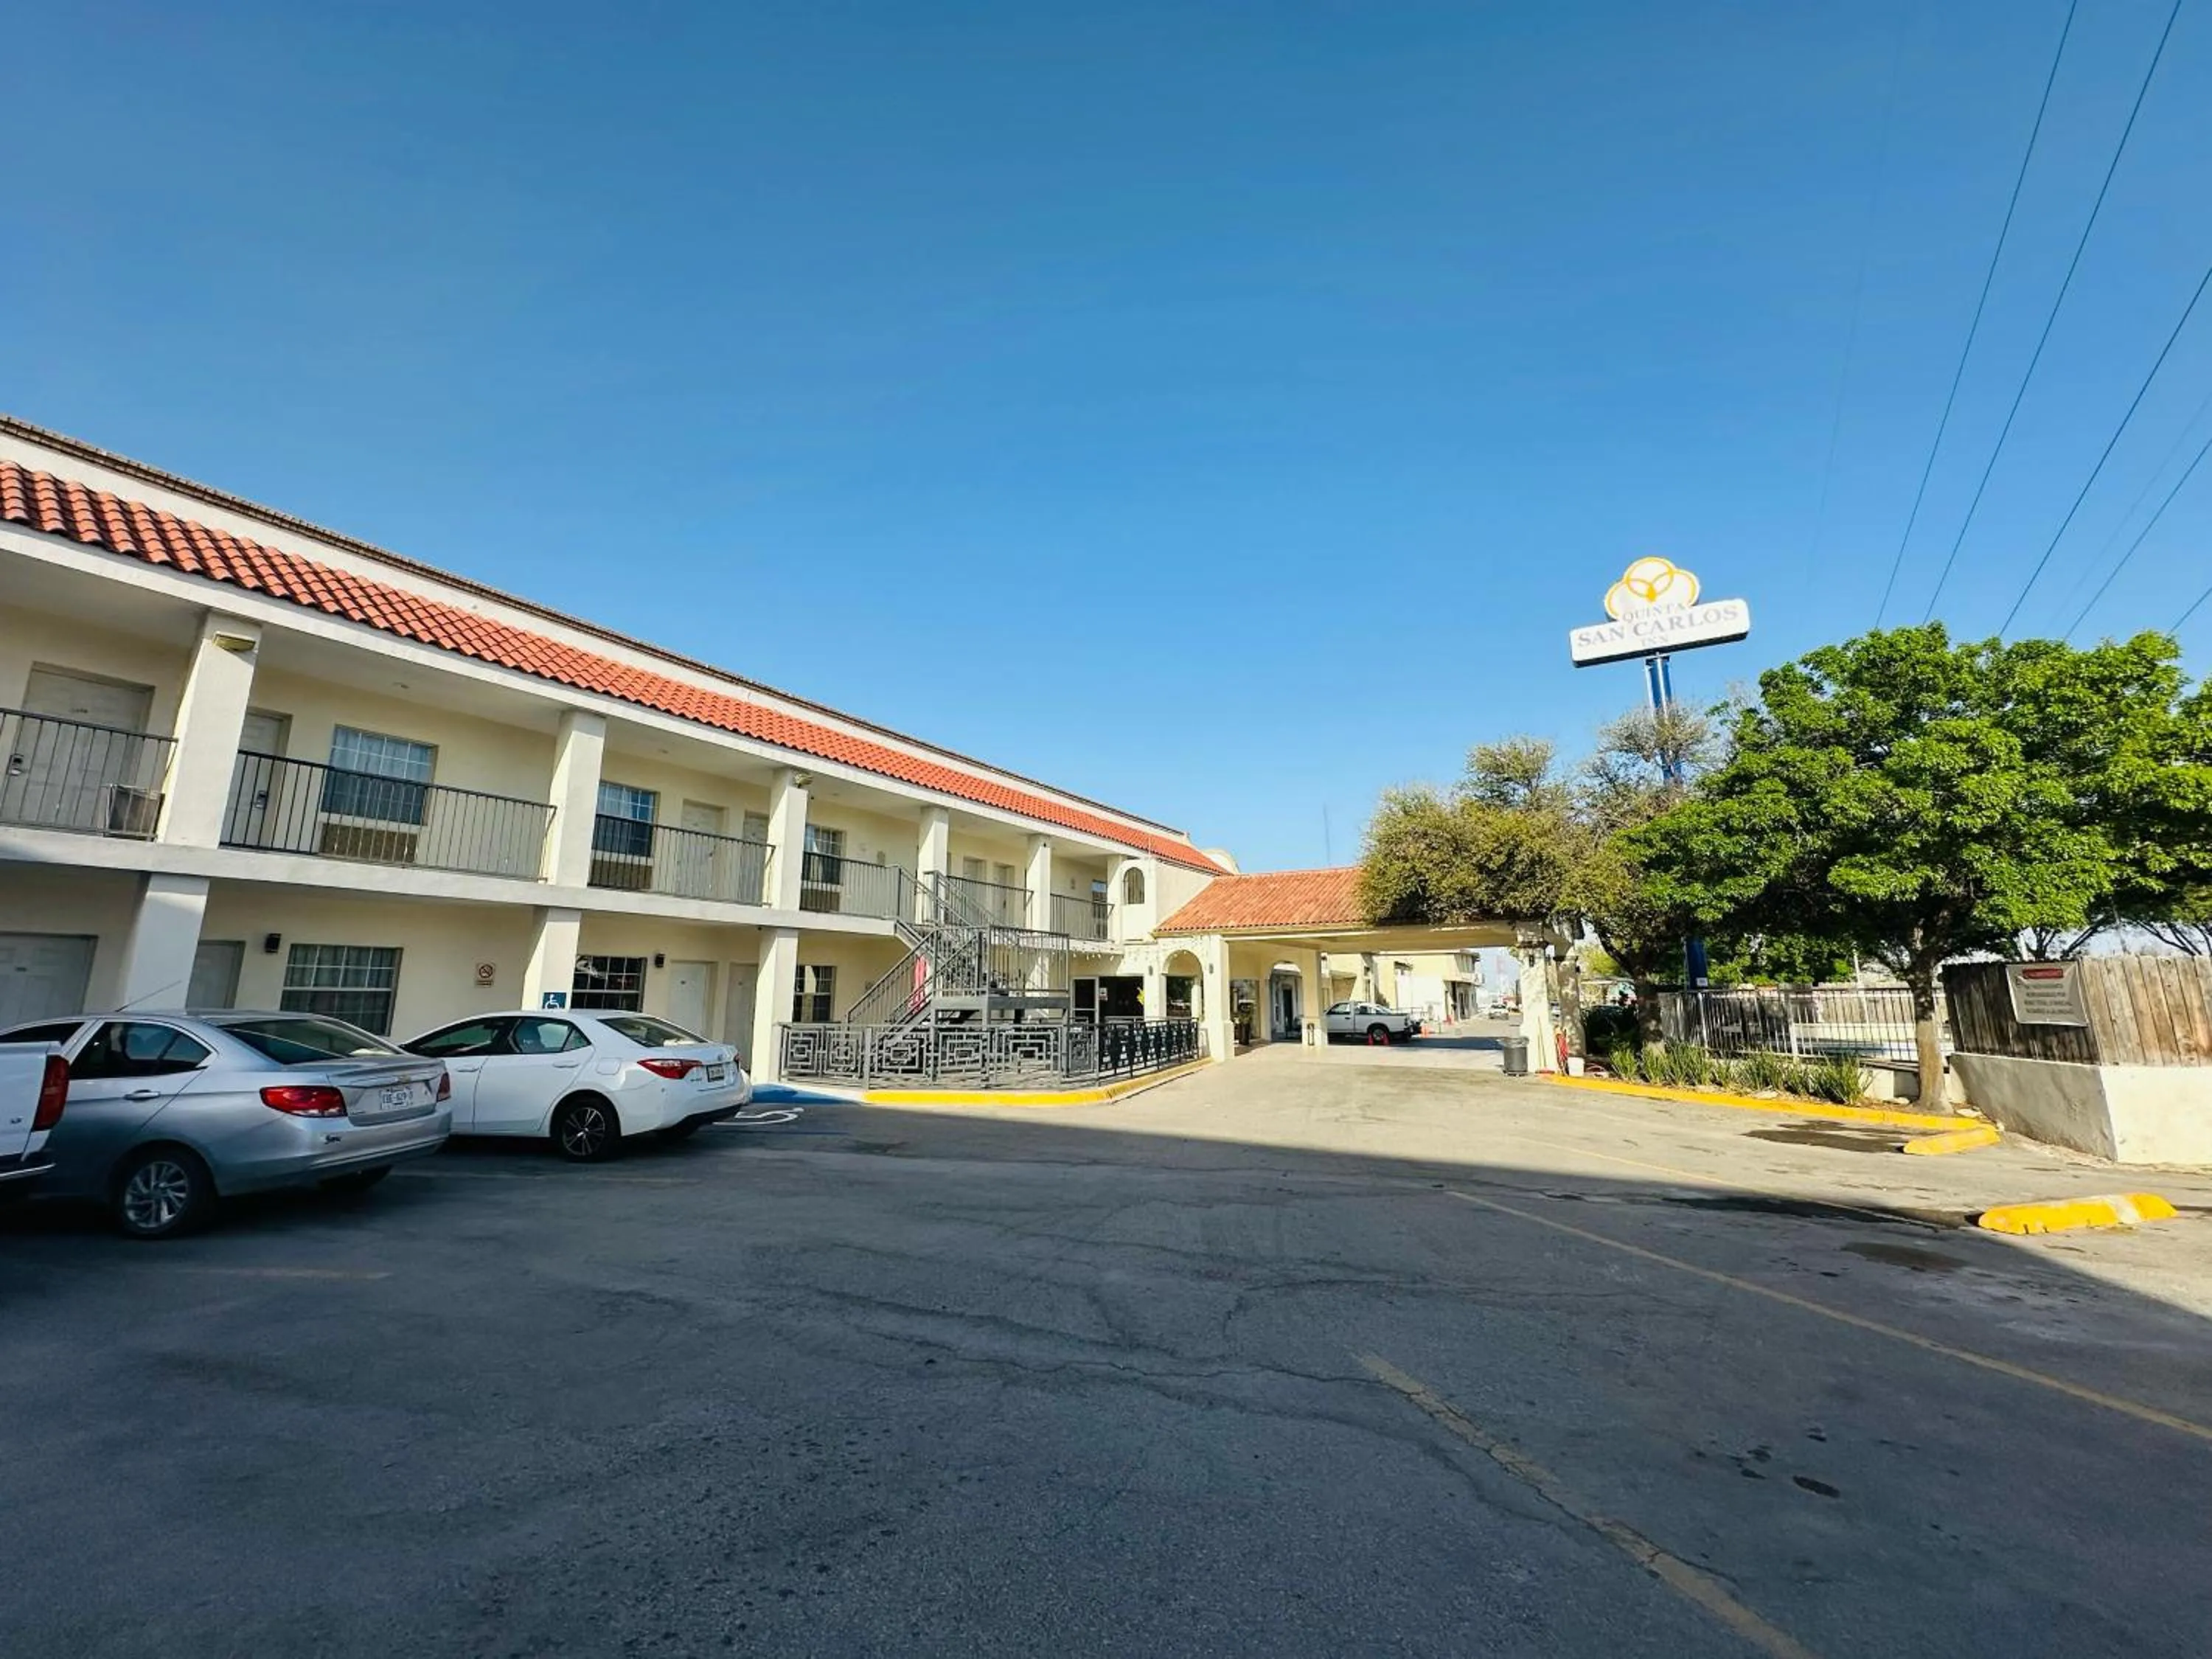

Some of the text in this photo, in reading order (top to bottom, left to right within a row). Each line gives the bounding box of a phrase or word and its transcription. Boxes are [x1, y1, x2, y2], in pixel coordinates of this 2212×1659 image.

[1623, 603, 1686, 623] QUINTA
[1578, 605, 1738, 647] SAN CARLOS
[1641, 635, 1669, 647] INN
